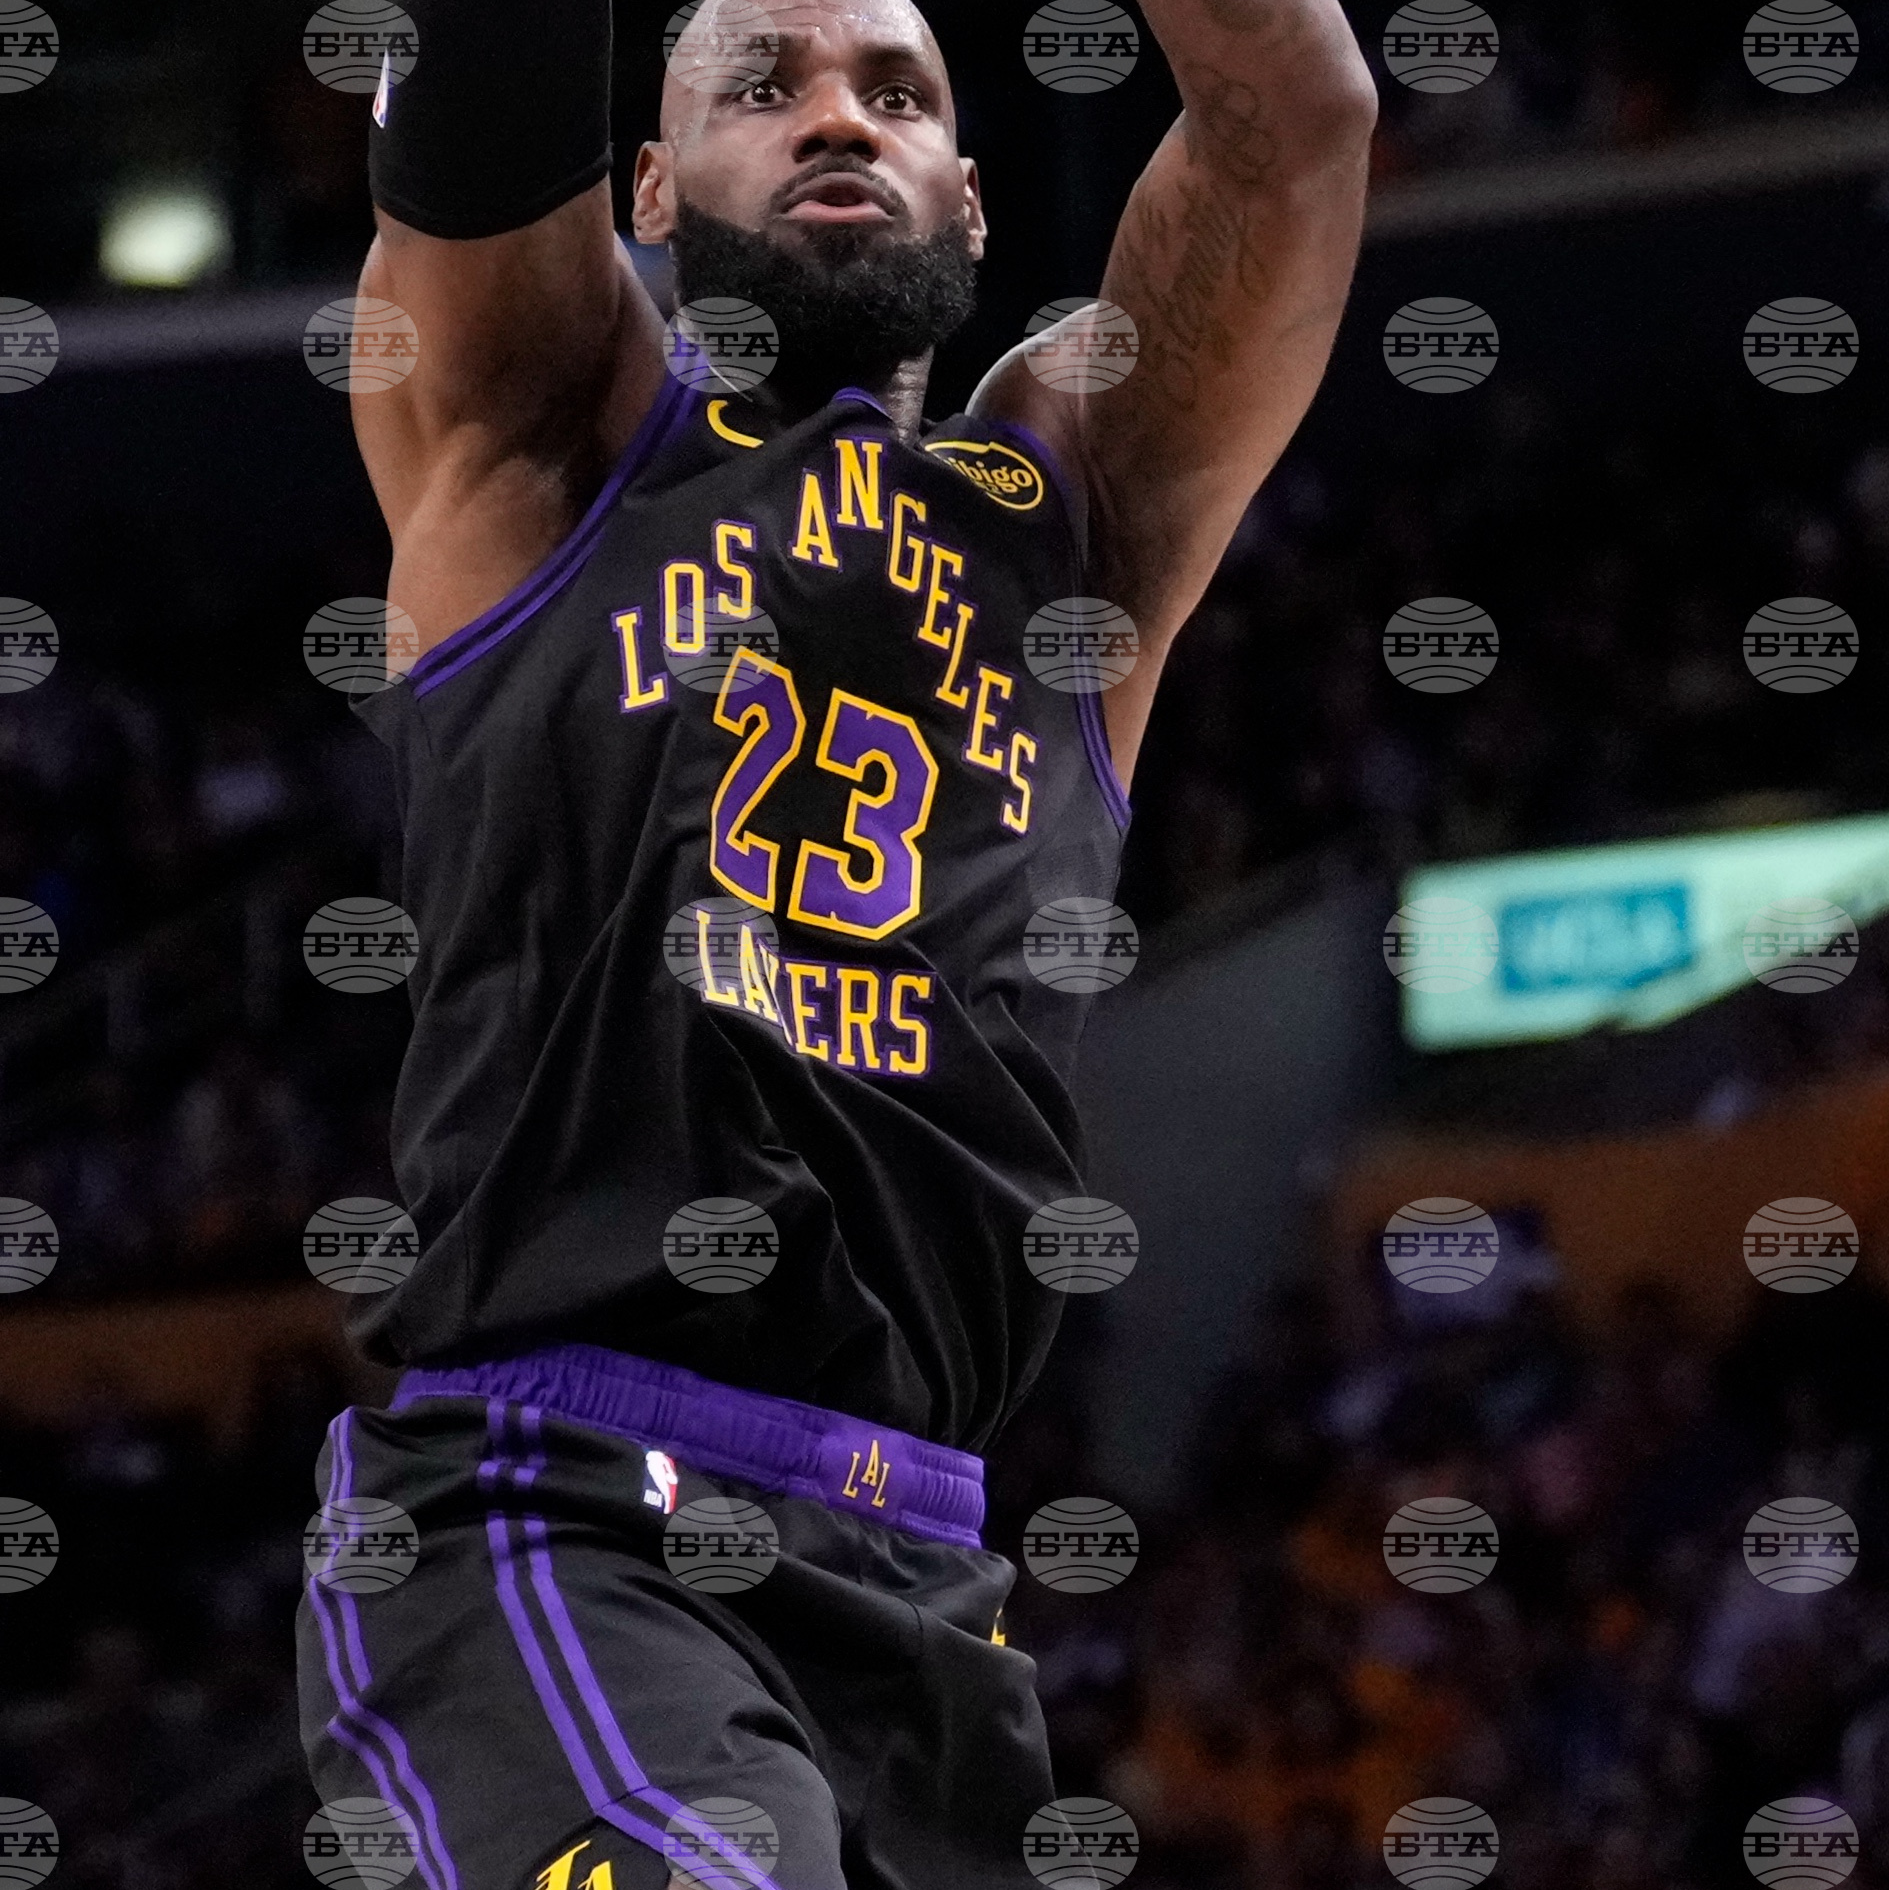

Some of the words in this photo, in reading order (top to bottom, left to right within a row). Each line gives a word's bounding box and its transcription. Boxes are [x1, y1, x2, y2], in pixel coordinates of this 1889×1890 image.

[613, 519, 757, 713] LOS
[791, 435, 1042, 838] ANGELES
[710, 645, 940, 941] 23
